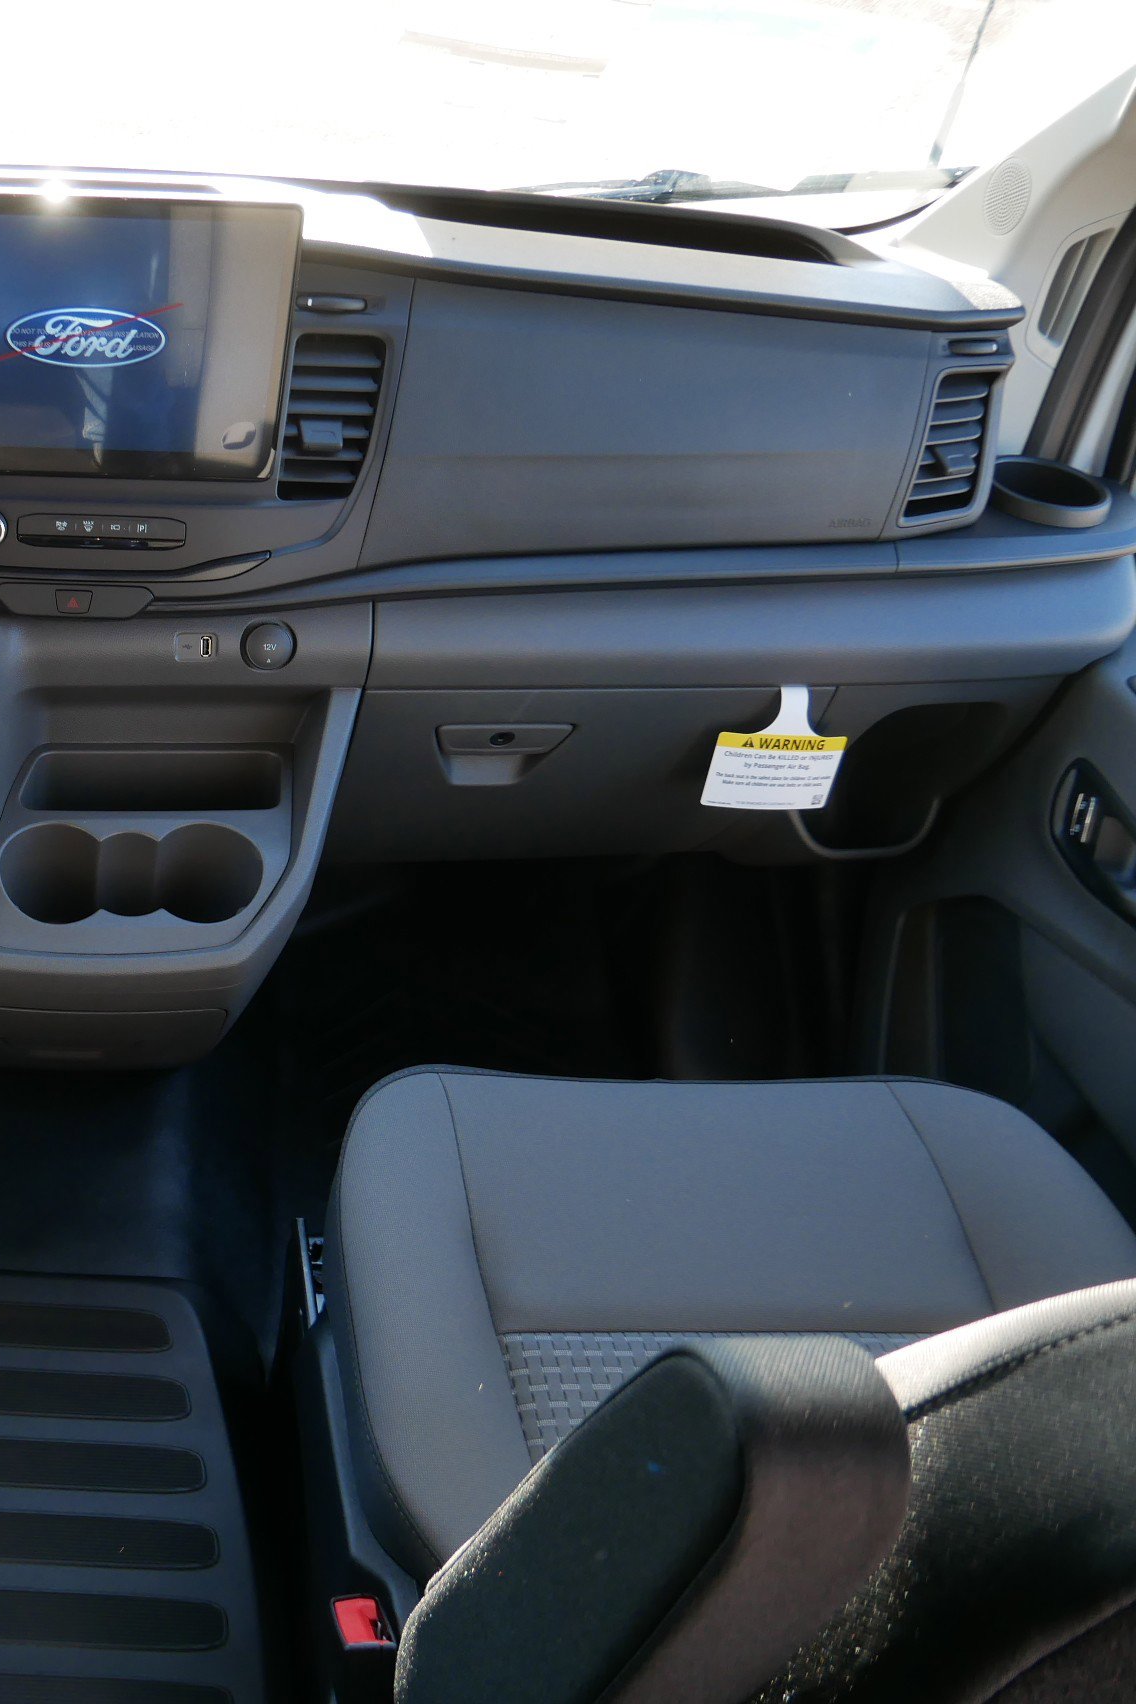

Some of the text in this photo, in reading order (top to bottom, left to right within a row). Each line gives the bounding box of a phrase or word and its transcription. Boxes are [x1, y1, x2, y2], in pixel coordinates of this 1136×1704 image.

[21, 327, 35, 335] NOT
[115, 330, 159, 340] INSTLATION
[35, 315, 138, 359] Ford
[263, 642, 277, 651] 12V
[759, 737, 826, 750] WARNING
[724, 750, 752, 759] Children
[754, 762, 785, 770] Passenger
